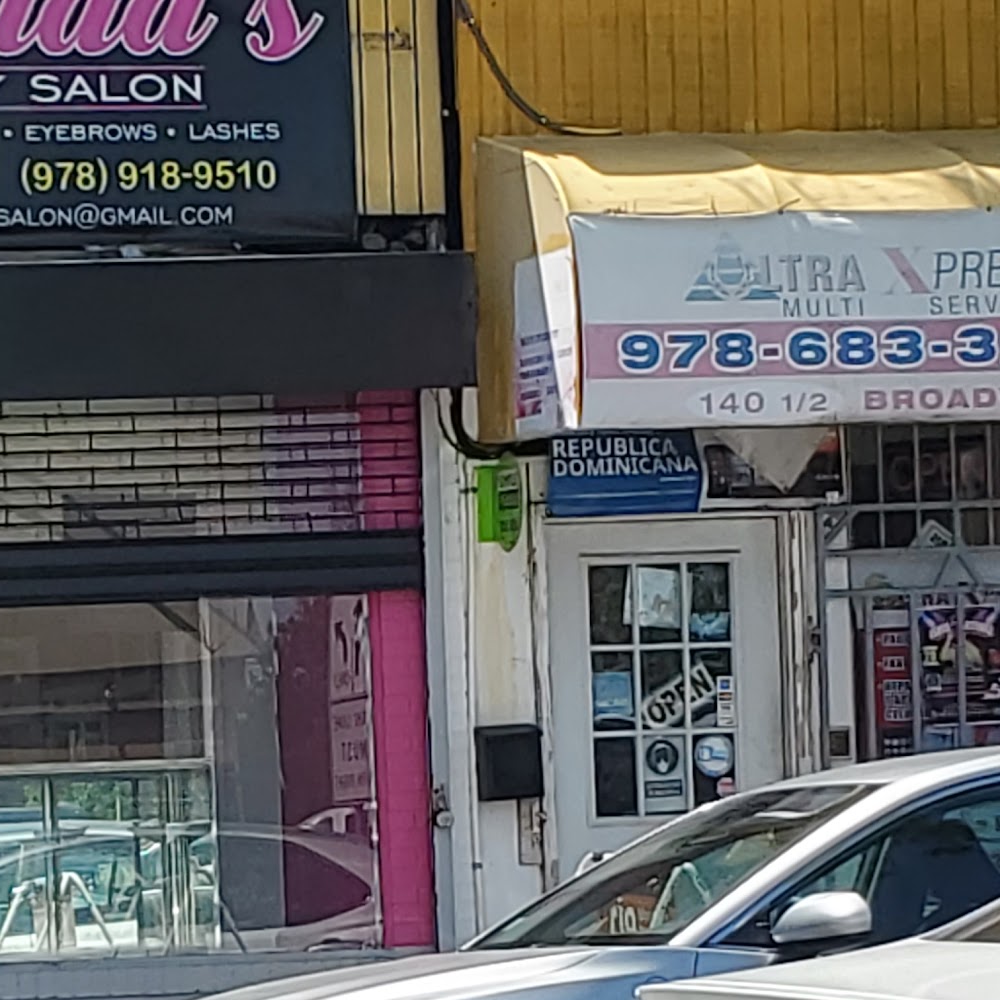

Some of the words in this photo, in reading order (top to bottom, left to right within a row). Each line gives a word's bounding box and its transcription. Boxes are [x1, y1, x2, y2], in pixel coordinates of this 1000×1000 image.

[29, 72, 203, 103] SALON
[24, 124, 158, 142] EYEBROWS
[188, 122, 281, 140] LASHES
[20, 157, 109, 196] (978)
[118, 160, 277, 191] 918-9510
[783, 297, 864, 318] MULTI
[929, 294, 998, 315] SERV
[617, 326, 997, 374] 978-683-3
[700, 392, 764, 415] 140
[781, 392, 828, 413] 1/2
[864, 387, 1000, 411] BROAD
[552, 437, 679, 458] REPUBLICA
[552, 455, 699, 478] DOMINICANA
[646, 668, 713, 724] OPEN
